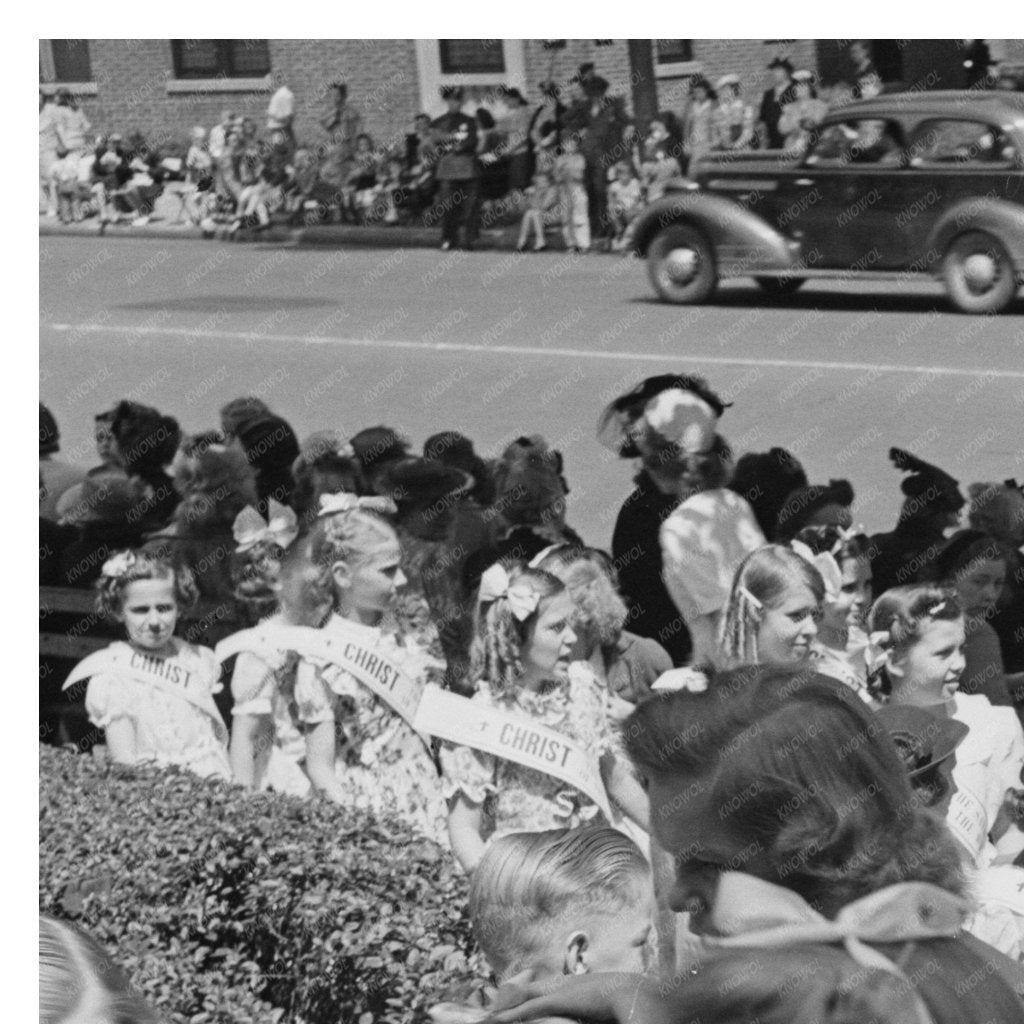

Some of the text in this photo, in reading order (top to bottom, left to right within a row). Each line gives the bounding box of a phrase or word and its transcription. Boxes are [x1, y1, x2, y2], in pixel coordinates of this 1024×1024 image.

[130, 652, 191, 688] CHRIST
[344, 643, 399, 691] CHRIST
[500, 723, 572, 767] CHRIST
